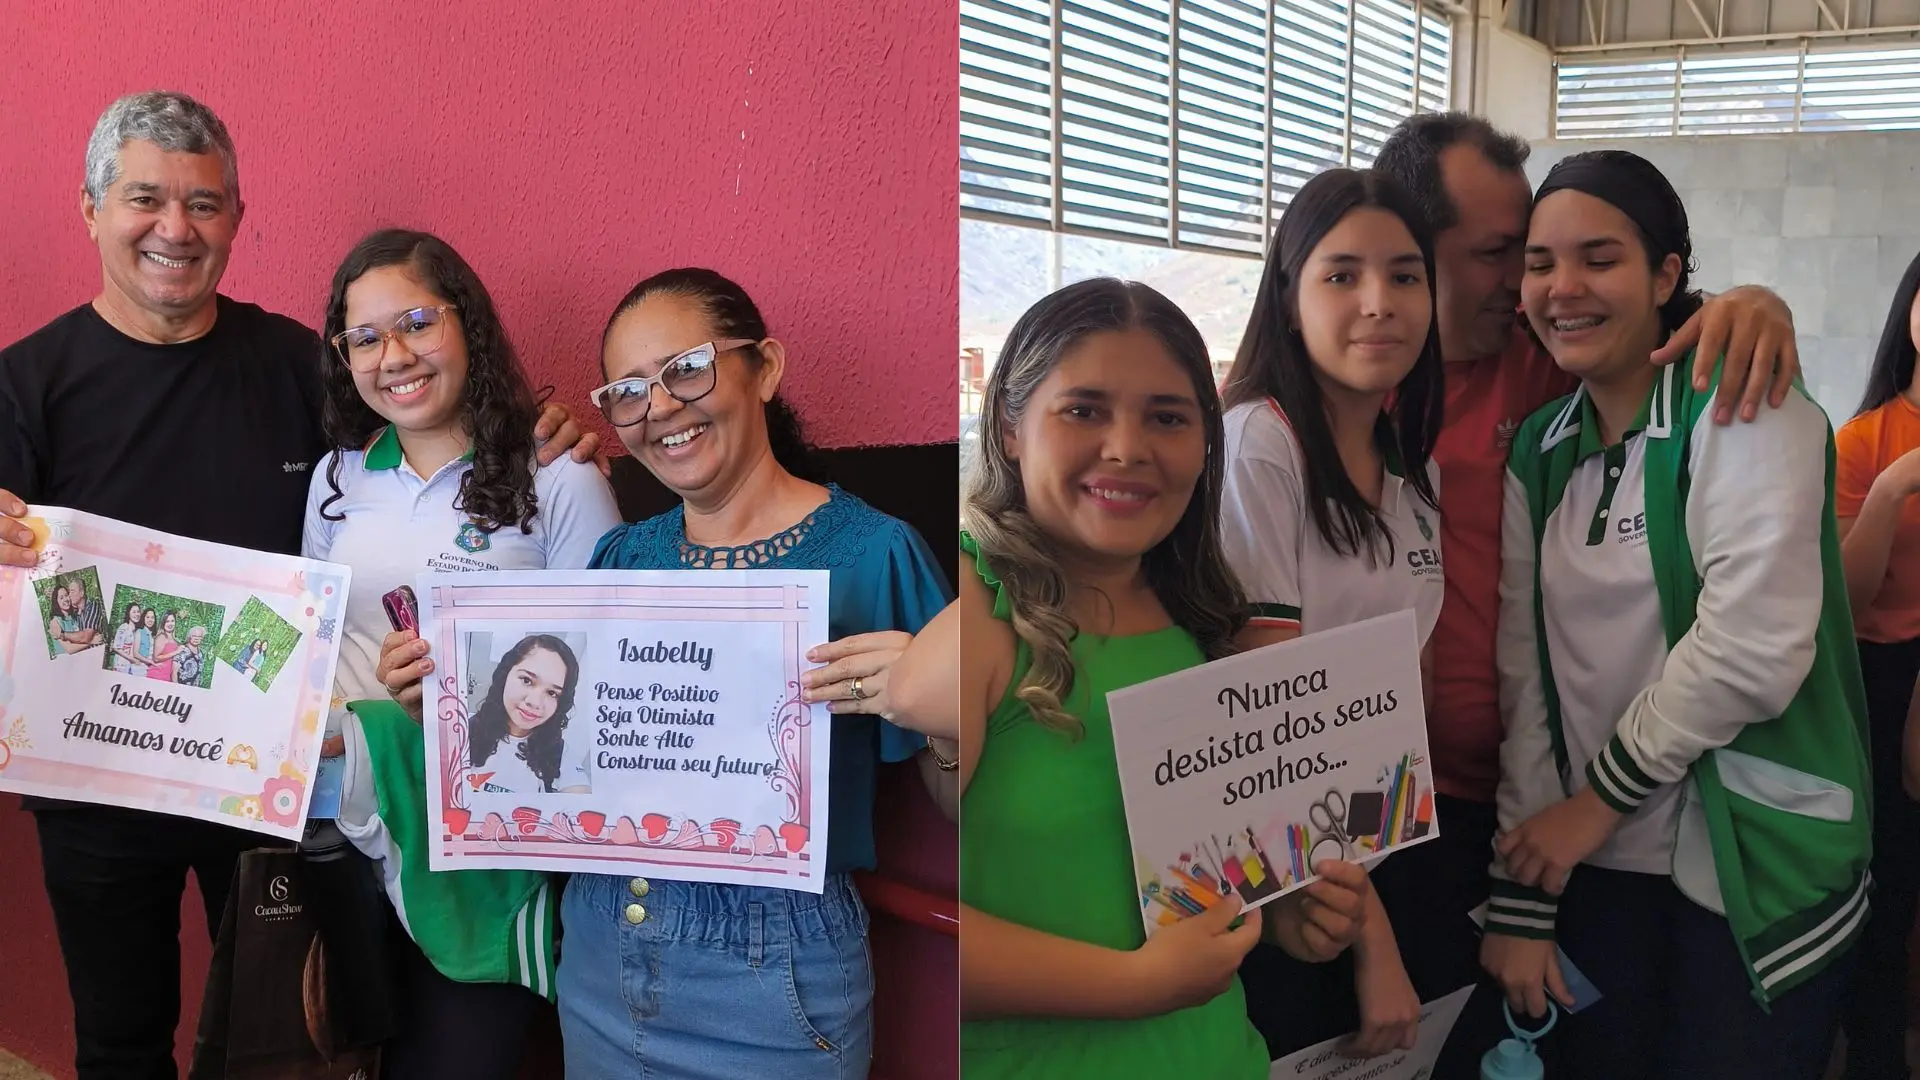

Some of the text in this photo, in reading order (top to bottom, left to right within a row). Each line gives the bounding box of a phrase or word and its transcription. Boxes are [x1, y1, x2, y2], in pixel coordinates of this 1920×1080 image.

[427, 559, 460, 571] ESTADO
[440, 553, 484, 568] GOVERNO
[617, 637, 714, 671] Isabelly
[110, 683, 193, 724] Isabelly
[594, 681, 720, 703] Pense Positivo
[1217, 667, 1329, 719] Nunca
[596, 704, 715, 727] Seja Otimista
[62, 711, 225, 762] Amamos você
[596, 727, 695, 749] Sonhe Alto
[1154, 688, 1399, 787] desista dos seus
[596, 750, 780, 778] Construa seu futuro!
[1222, 751, 1348, 806] sonhos...
